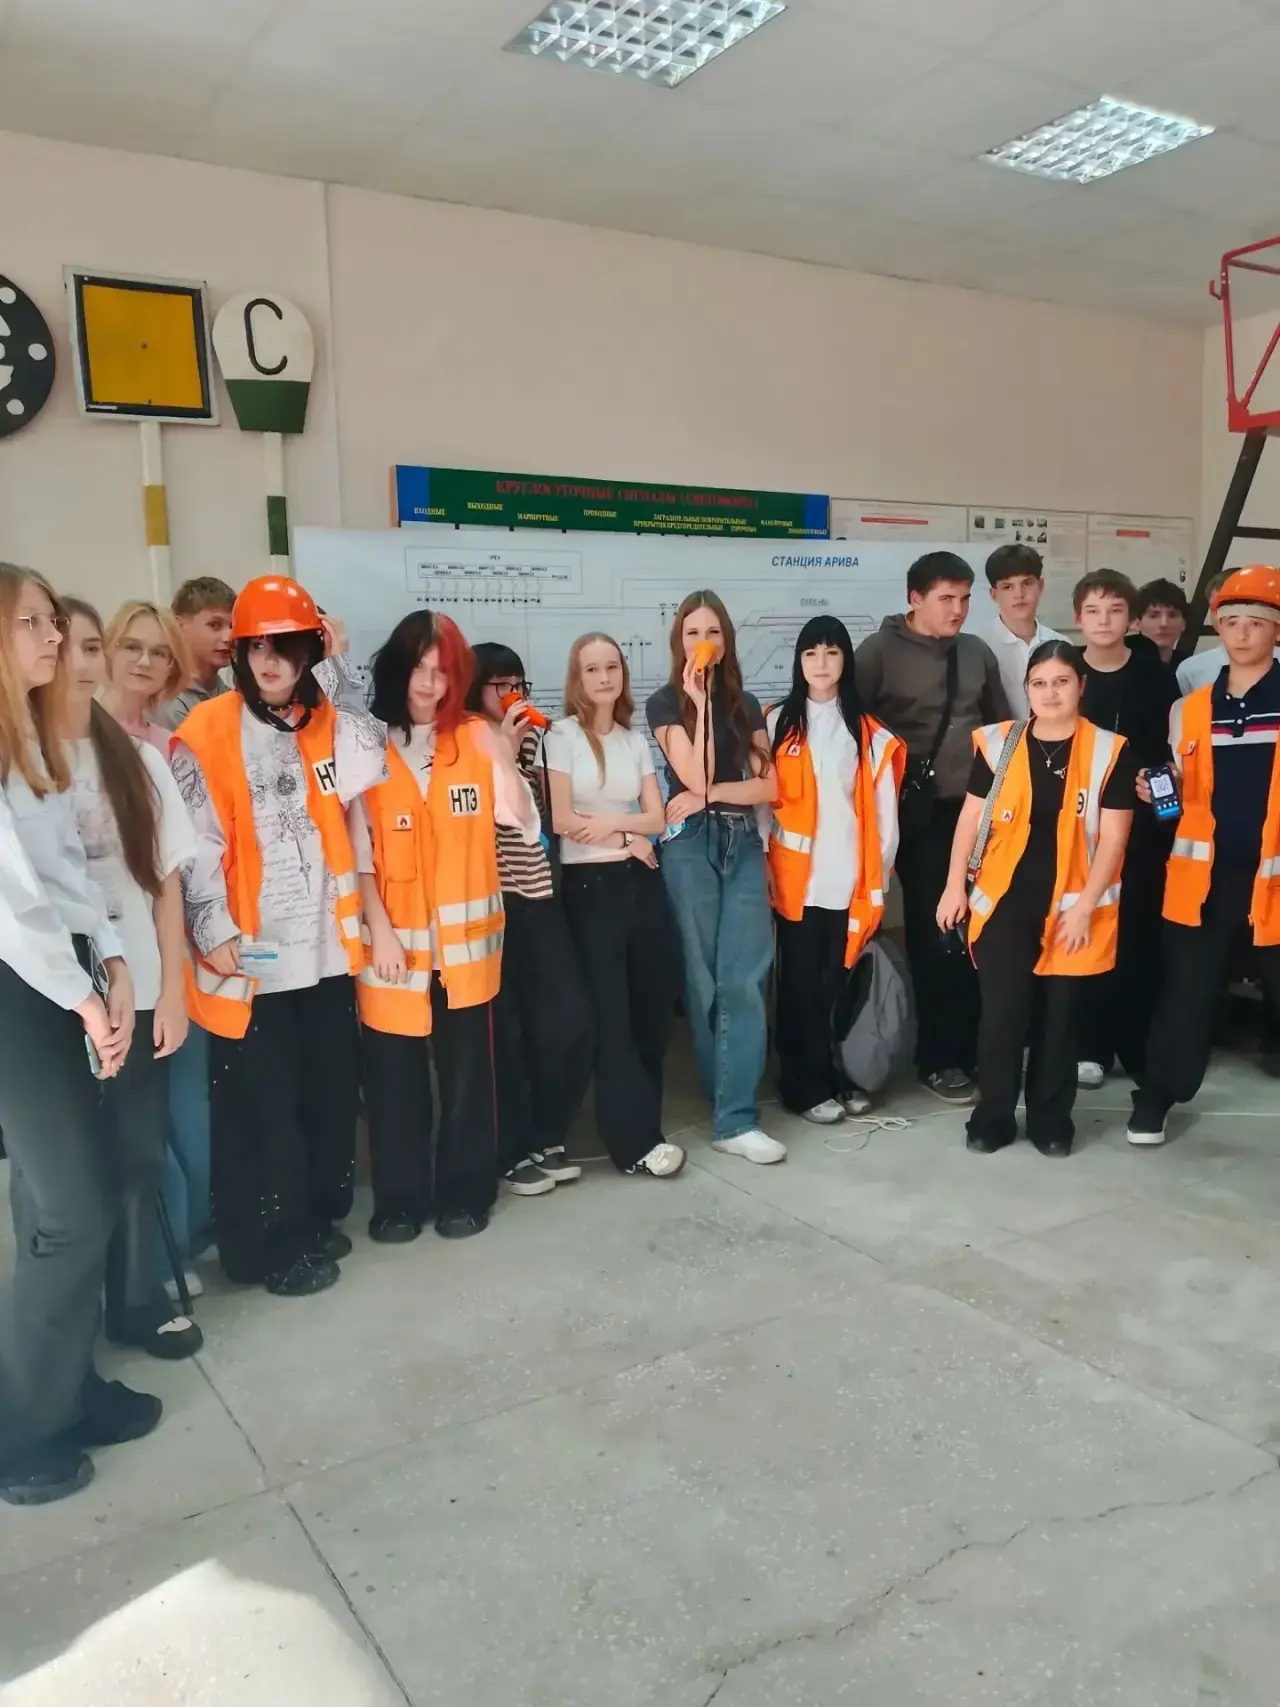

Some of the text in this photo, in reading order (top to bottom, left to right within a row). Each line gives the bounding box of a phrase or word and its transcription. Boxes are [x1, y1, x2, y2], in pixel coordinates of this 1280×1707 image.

[414, 507, 445, 516] ВХОДНЫЕ
[772, 555, 859, 569] СТАНЦИЯ АРИВА
[315, 761, 337, 791] НТ
[450, 787, 478, 813] НТЭ
